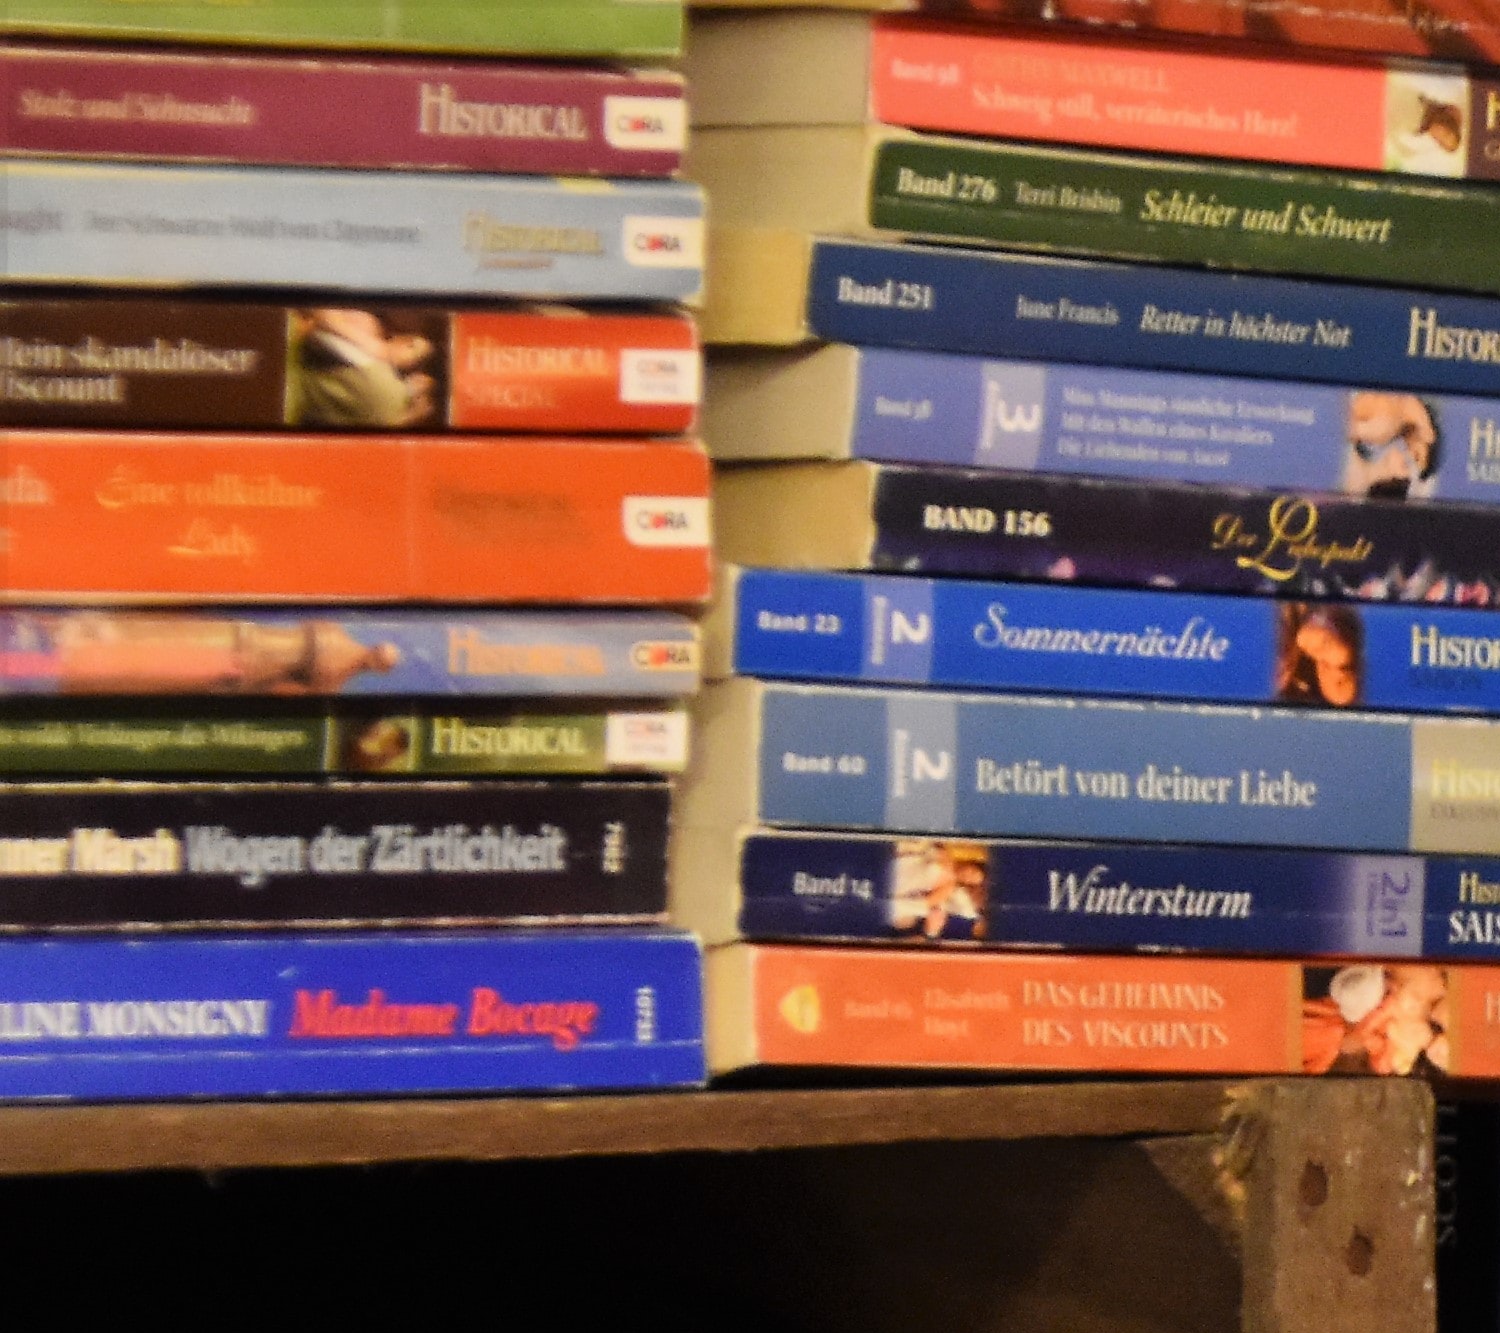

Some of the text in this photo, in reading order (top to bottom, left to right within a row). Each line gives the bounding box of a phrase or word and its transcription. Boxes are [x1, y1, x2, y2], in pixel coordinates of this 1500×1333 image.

[898, 168, 942, 199] Band
[947, 172, 995, 202] 276
[1141, 190, 1234, 232] Schleier
[1243, 203, 1288, 236] und
[1295, 206, 1390, 245] Schwert
[923, 502, 1051, 537] BAND 156
[975, 606, 1229, 663] Sommernächte
[975, 756, 1316, 808] Betört von deiner Liebe
[184, 827, 301, 885] Wogen
[311, 827, 360, 871] der
[371, 823, 565, 871] Zärtlichkeit
[84, 987, 598, 1050] MONSIGNY Madame Bocage
